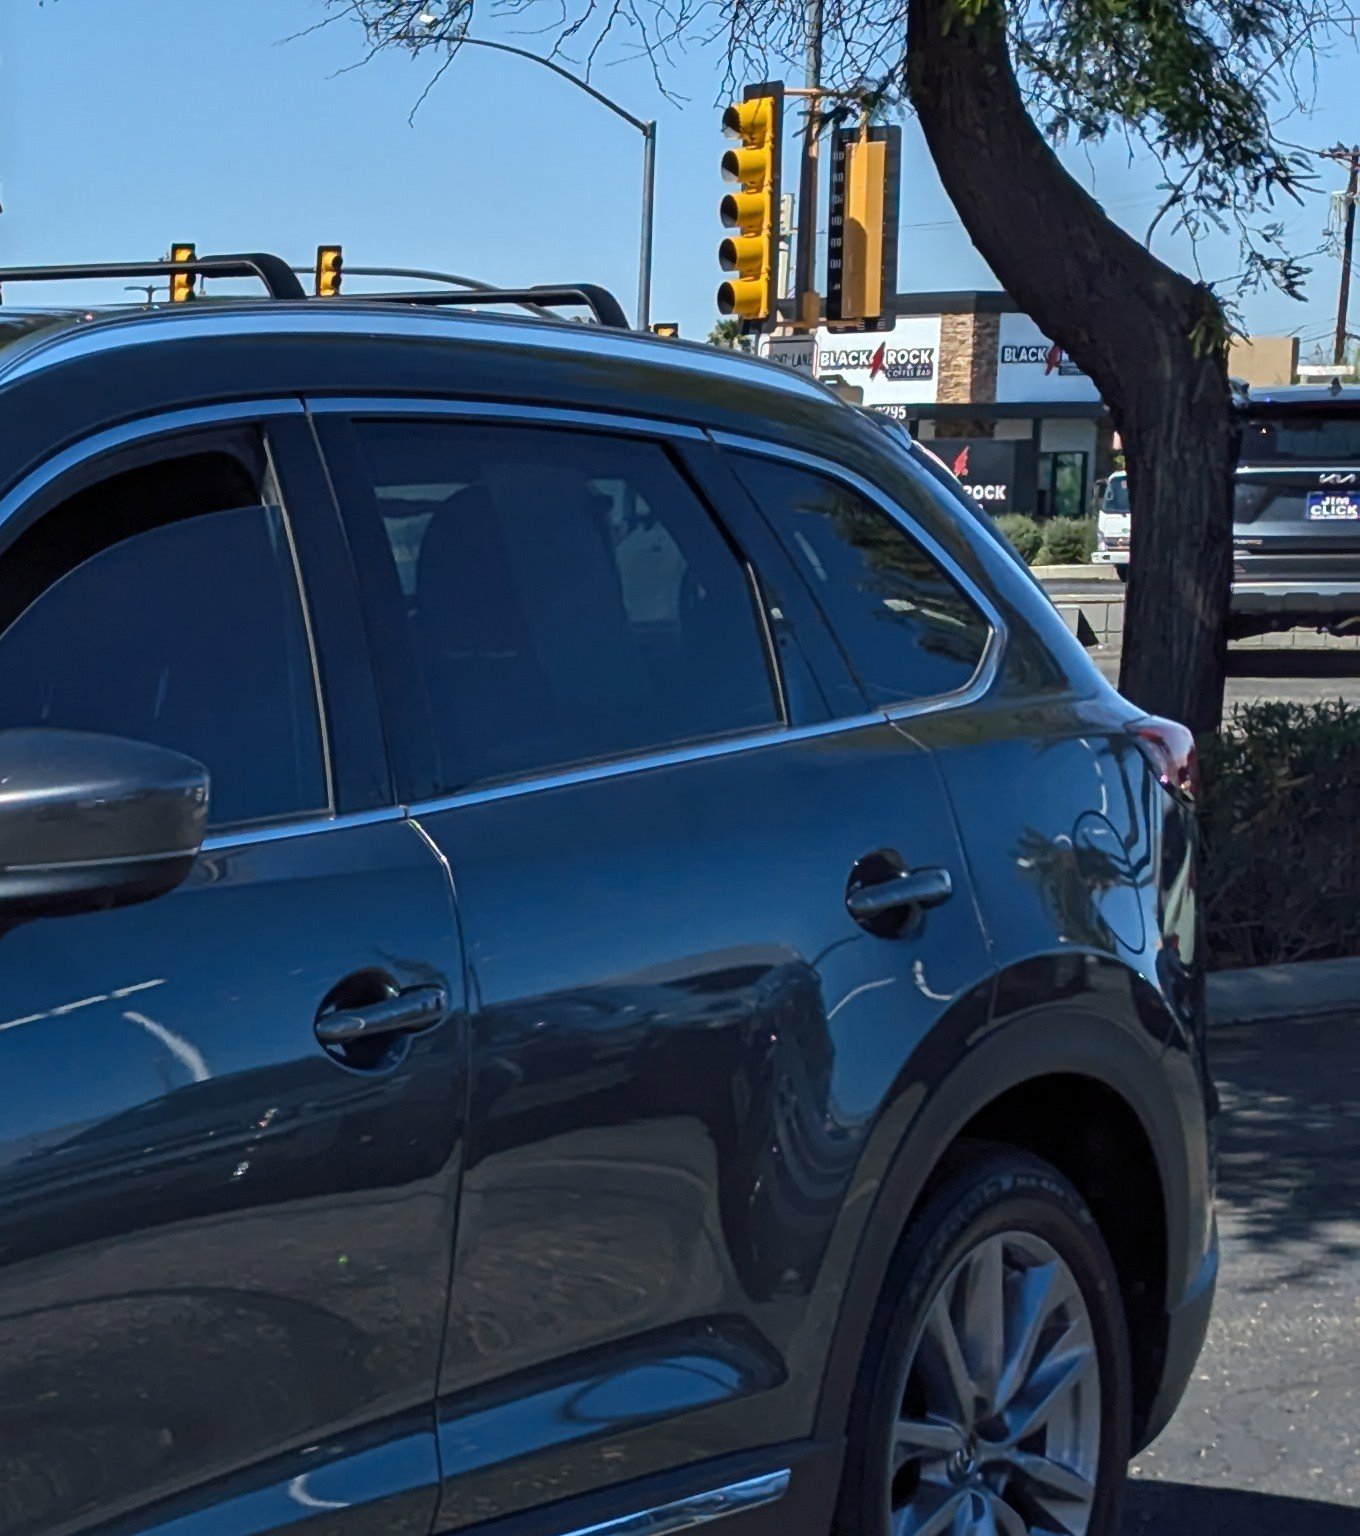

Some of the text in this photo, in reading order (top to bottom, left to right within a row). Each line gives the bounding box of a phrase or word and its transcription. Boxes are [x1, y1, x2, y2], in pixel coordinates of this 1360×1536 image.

[820, 349, 931, 367] BLACK ROCK
[1004, 347, 1047, 362] BLACK
[1321, 496, 1350, 506] JIM
[1310, 504, 1358, 515] CLICK
